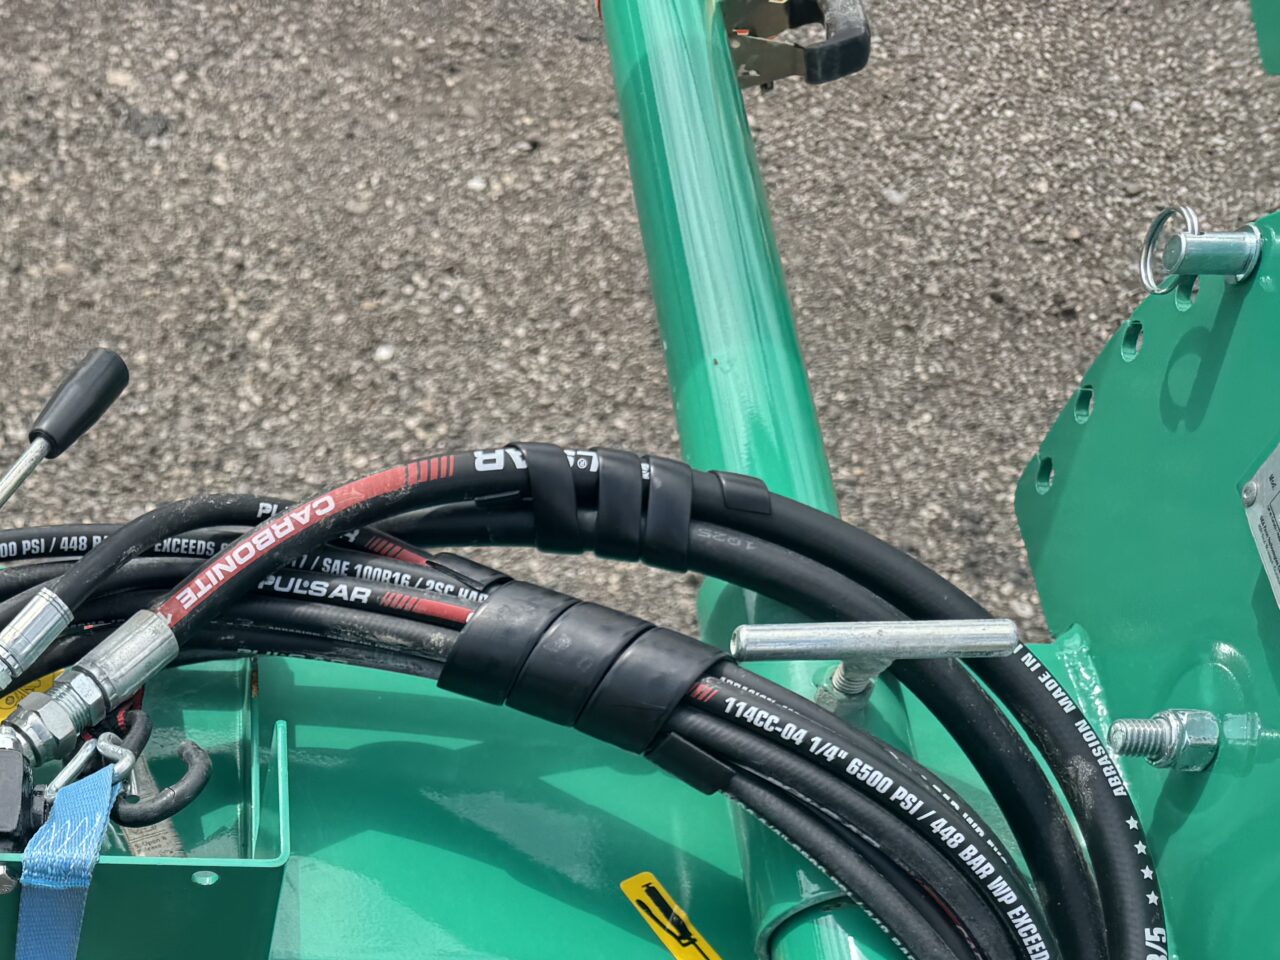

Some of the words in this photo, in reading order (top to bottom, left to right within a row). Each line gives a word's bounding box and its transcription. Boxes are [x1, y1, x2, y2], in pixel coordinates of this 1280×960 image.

[21, 536, 47, 557] PSI
[59, 534, 89, 553] 448
[154, 537, 217, 557] EXCEEDS
[179, 494, 337, 612] CARBONITE
[256, 574, 373, 604] PULSAR
[319, 556, 351, 578] SAE
[353, 563, 411, 589] 100R16
[1019, 653, 1045, 679] IN
[1038, 671, 1077, 717] MADE
[1073, 718, 1129, 799] ABRASION
[723, 695, 809, 747] 114CC-04
[809, 734, 849, 763] 1/4"
[844, 756, 894, 795] 6500
[889, 783, 925, 816] PSI
[929, 816, 966, 850] 448
[957, 843, 996, 881] BAR
[986, 874, 1019, 907] WP
